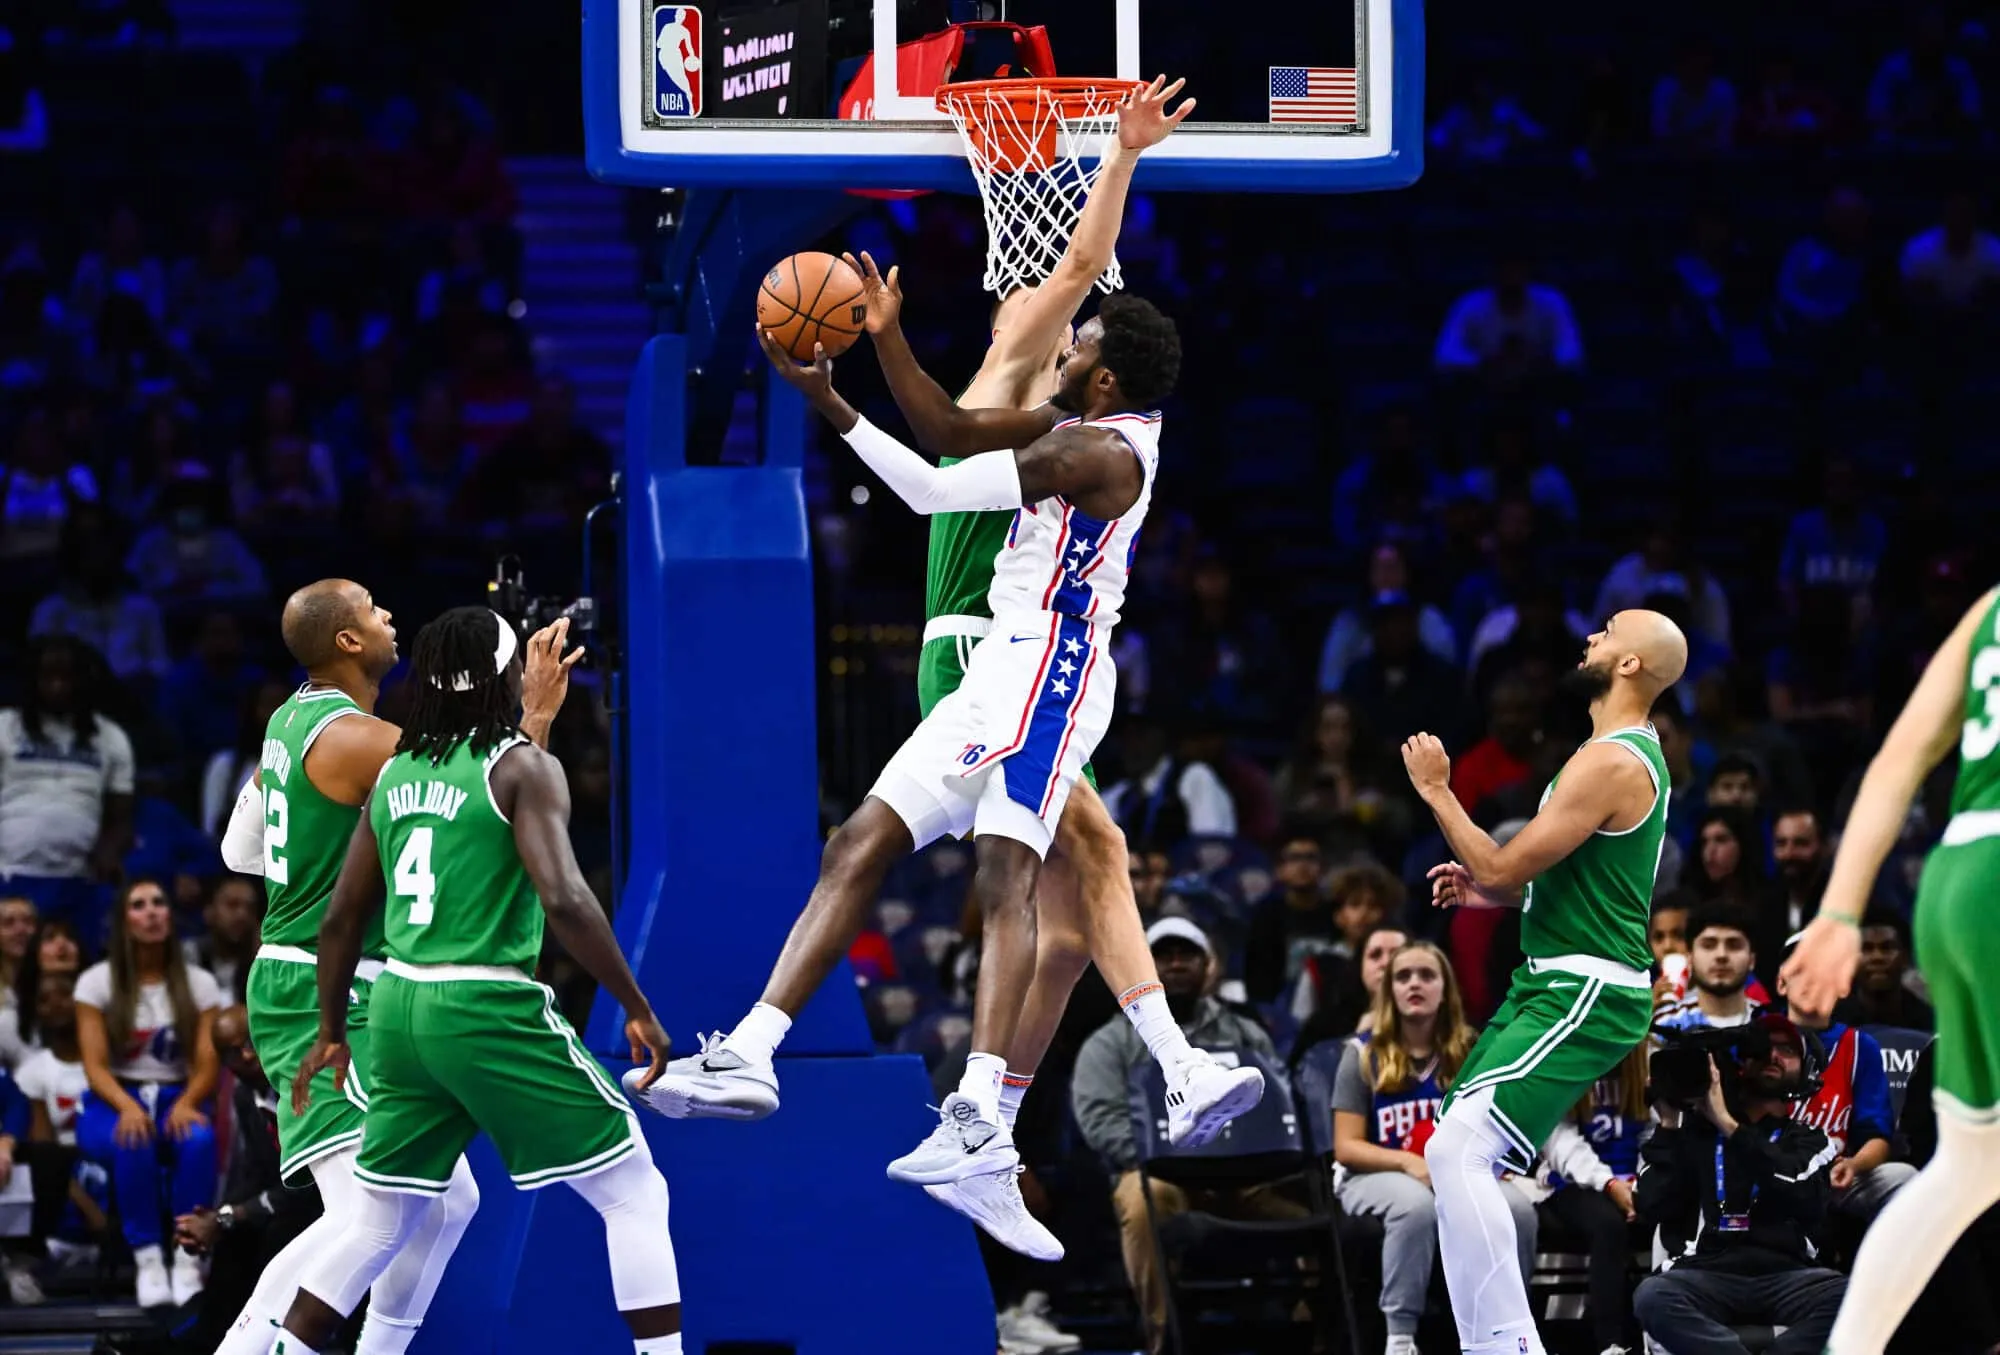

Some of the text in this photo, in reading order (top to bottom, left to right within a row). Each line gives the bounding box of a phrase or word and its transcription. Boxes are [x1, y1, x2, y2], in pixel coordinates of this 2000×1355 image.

[661, 93, 684, 111] NBA
[955, 743, 986, 765] 76
[386, 780, 468, 822] HOLIDAY
[262, 783, 288, 885] 2
[394, 826, 436, 925] 4
[1592, 1113, 1623, 1141] 21
